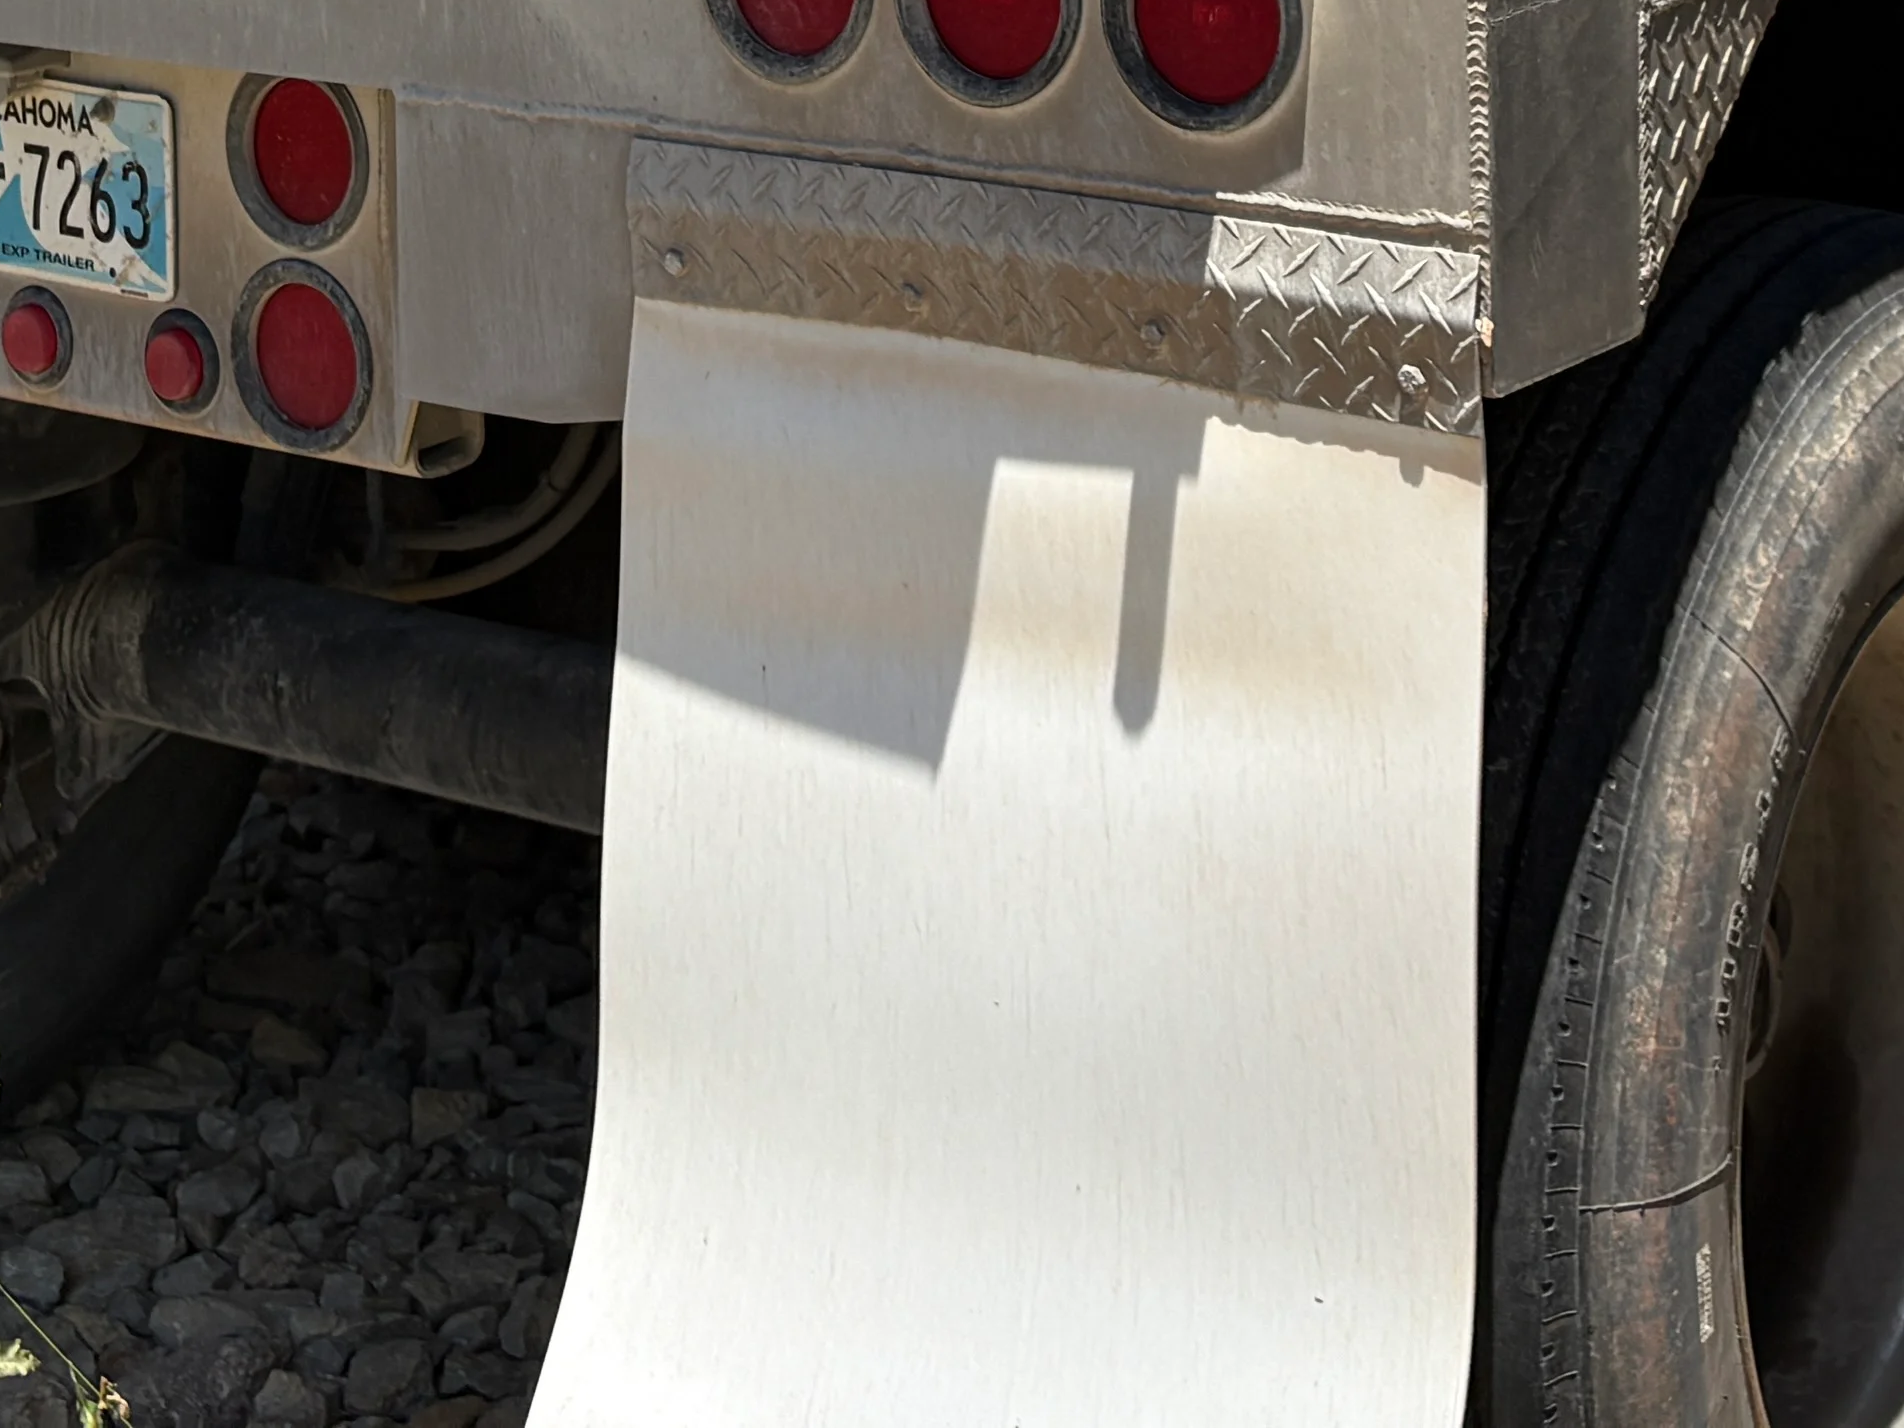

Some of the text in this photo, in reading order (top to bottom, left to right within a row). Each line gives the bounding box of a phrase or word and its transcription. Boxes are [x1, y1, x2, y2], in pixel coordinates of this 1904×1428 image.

[23, 142, 152, 250] 7263
[2, 242, 29, 259] EXP
[34, 248, 95, 272] TRAILER
